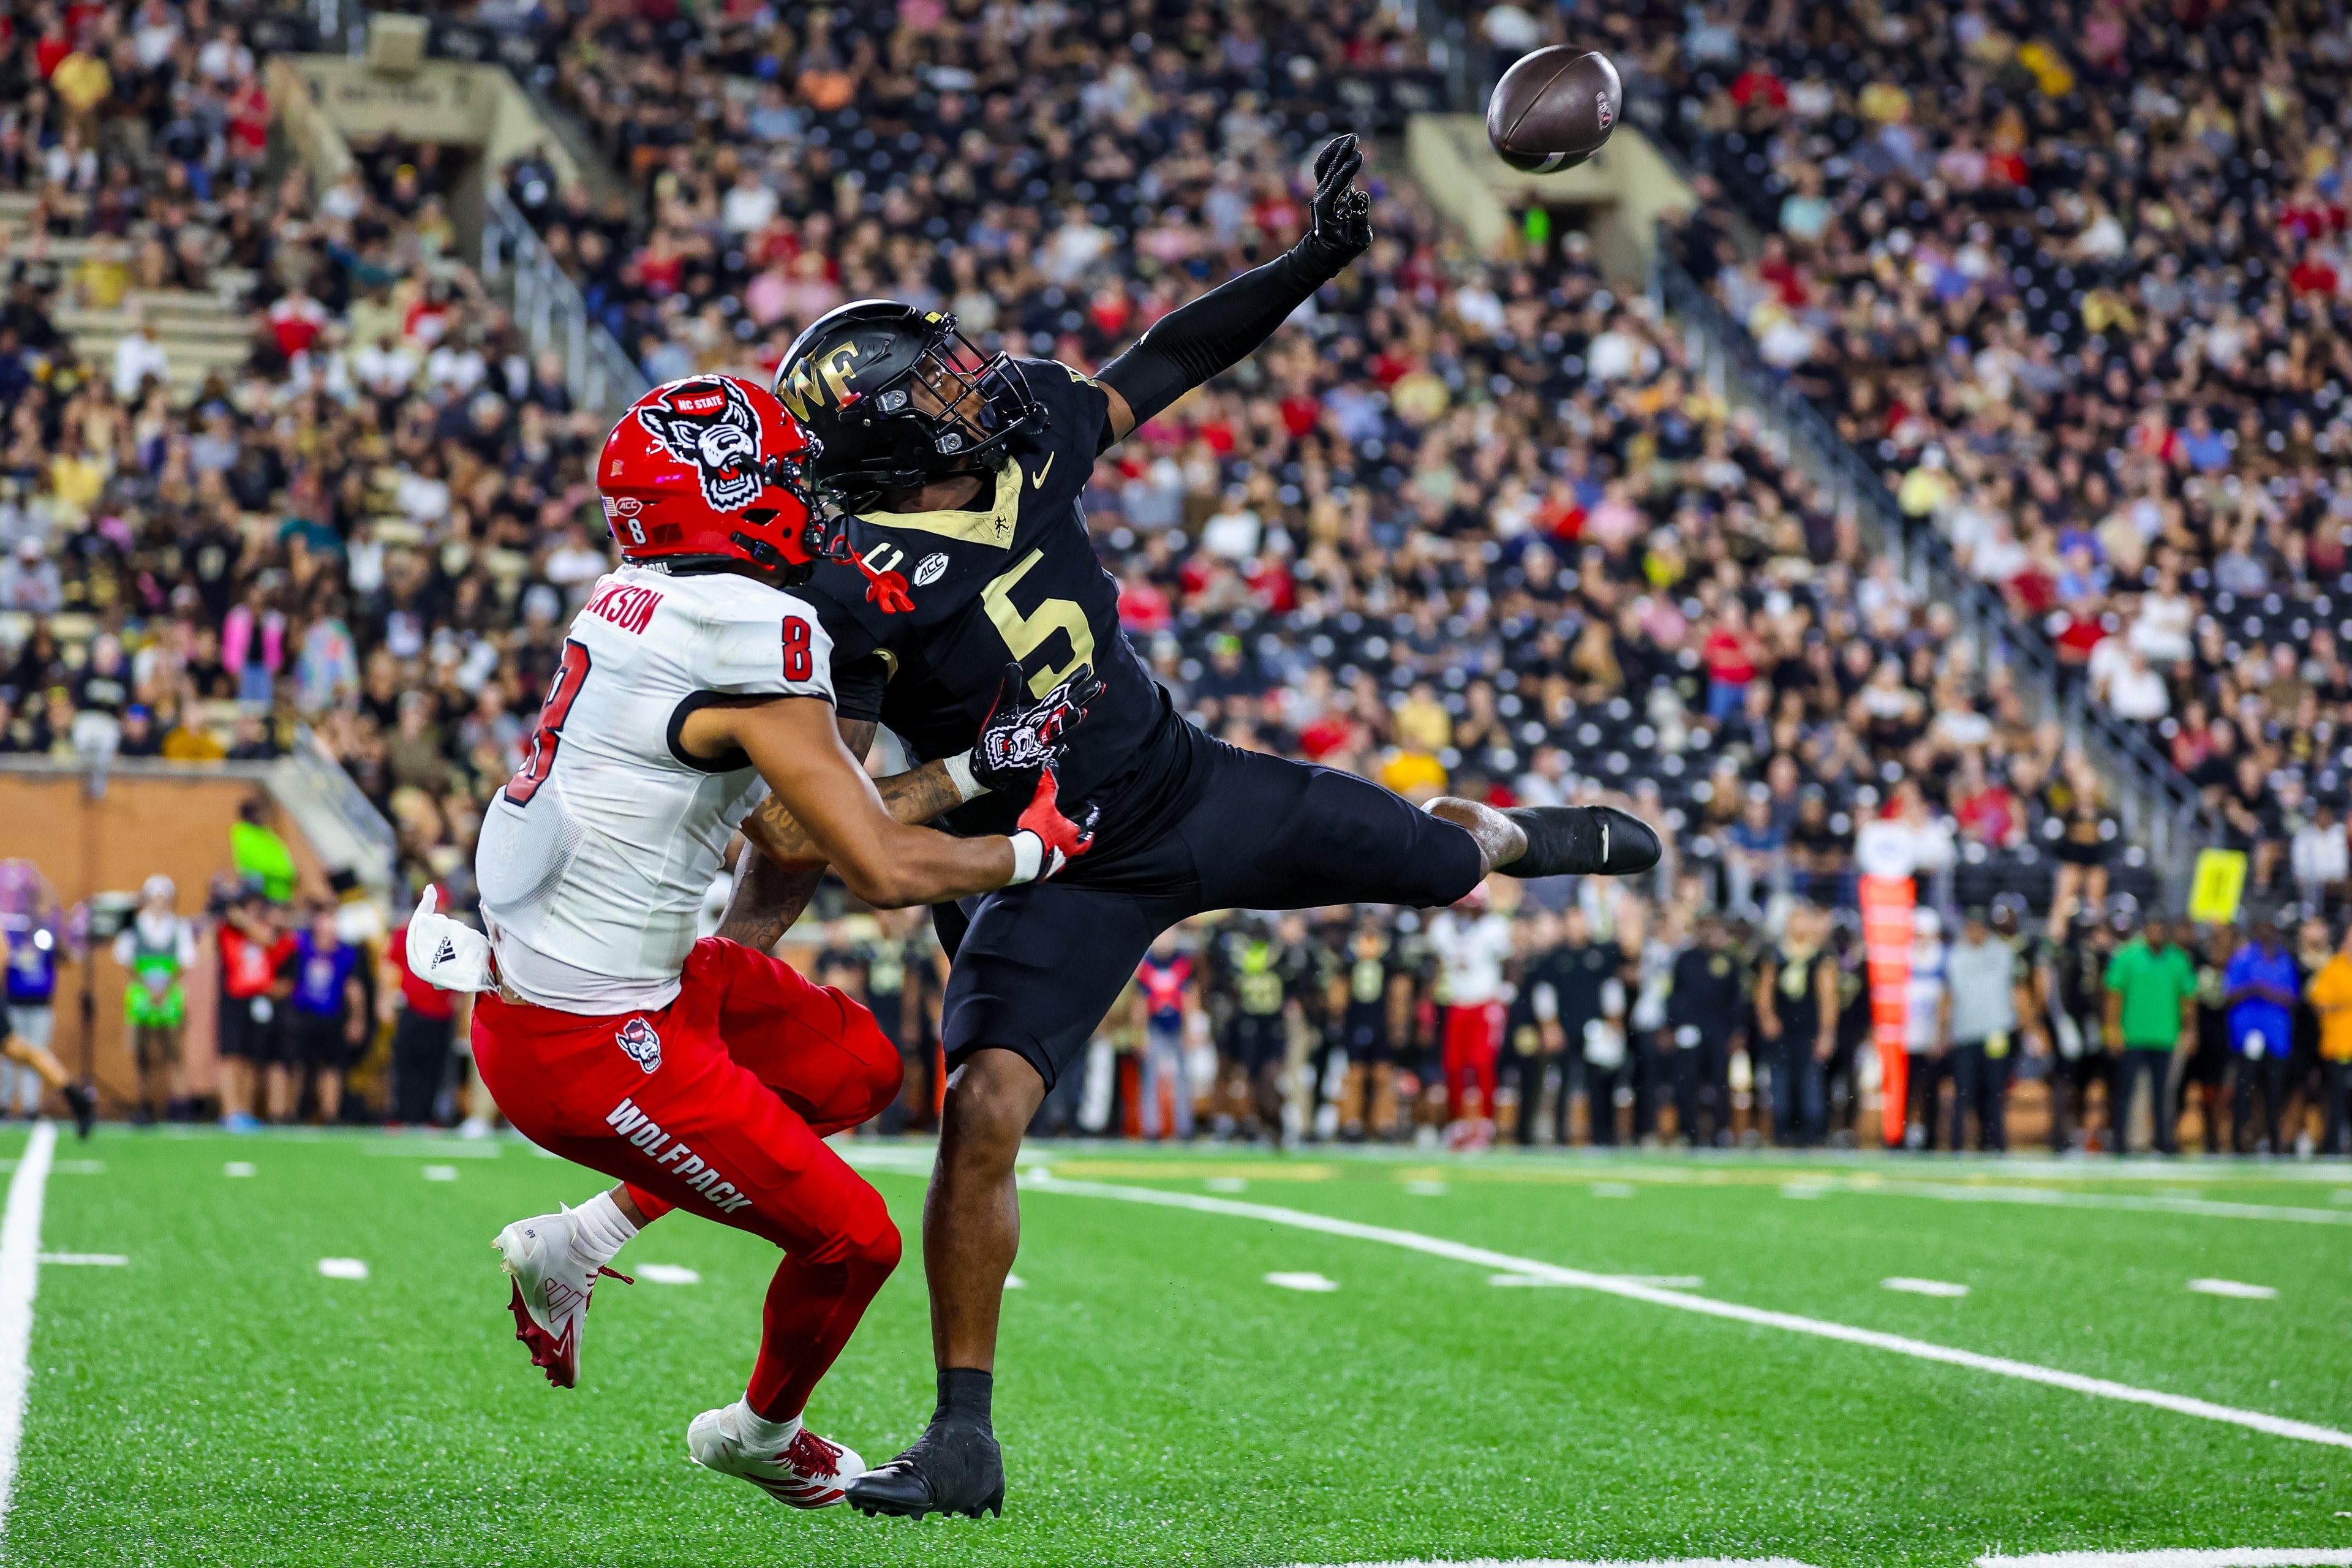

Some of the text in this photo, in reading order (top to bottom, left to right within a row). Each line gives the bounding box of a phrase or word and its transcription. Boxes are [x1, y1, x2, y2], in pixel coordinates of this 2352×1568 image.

[677, 395, 723, 410] NC STATE
[775, 341, 861, 422] WF
[619, 501, 637, 510] ACC
[628, 518, 646, 544] 8
[919, 554, 944, 581] ACC
[782, 616, 812, 682] 8
[980, 548, 1095, 700] 5
[504, 638, 592, 808] 8
[431, 936, 448, 970] adidas
[605, 1097, 753, 1214] WOLFPACK
